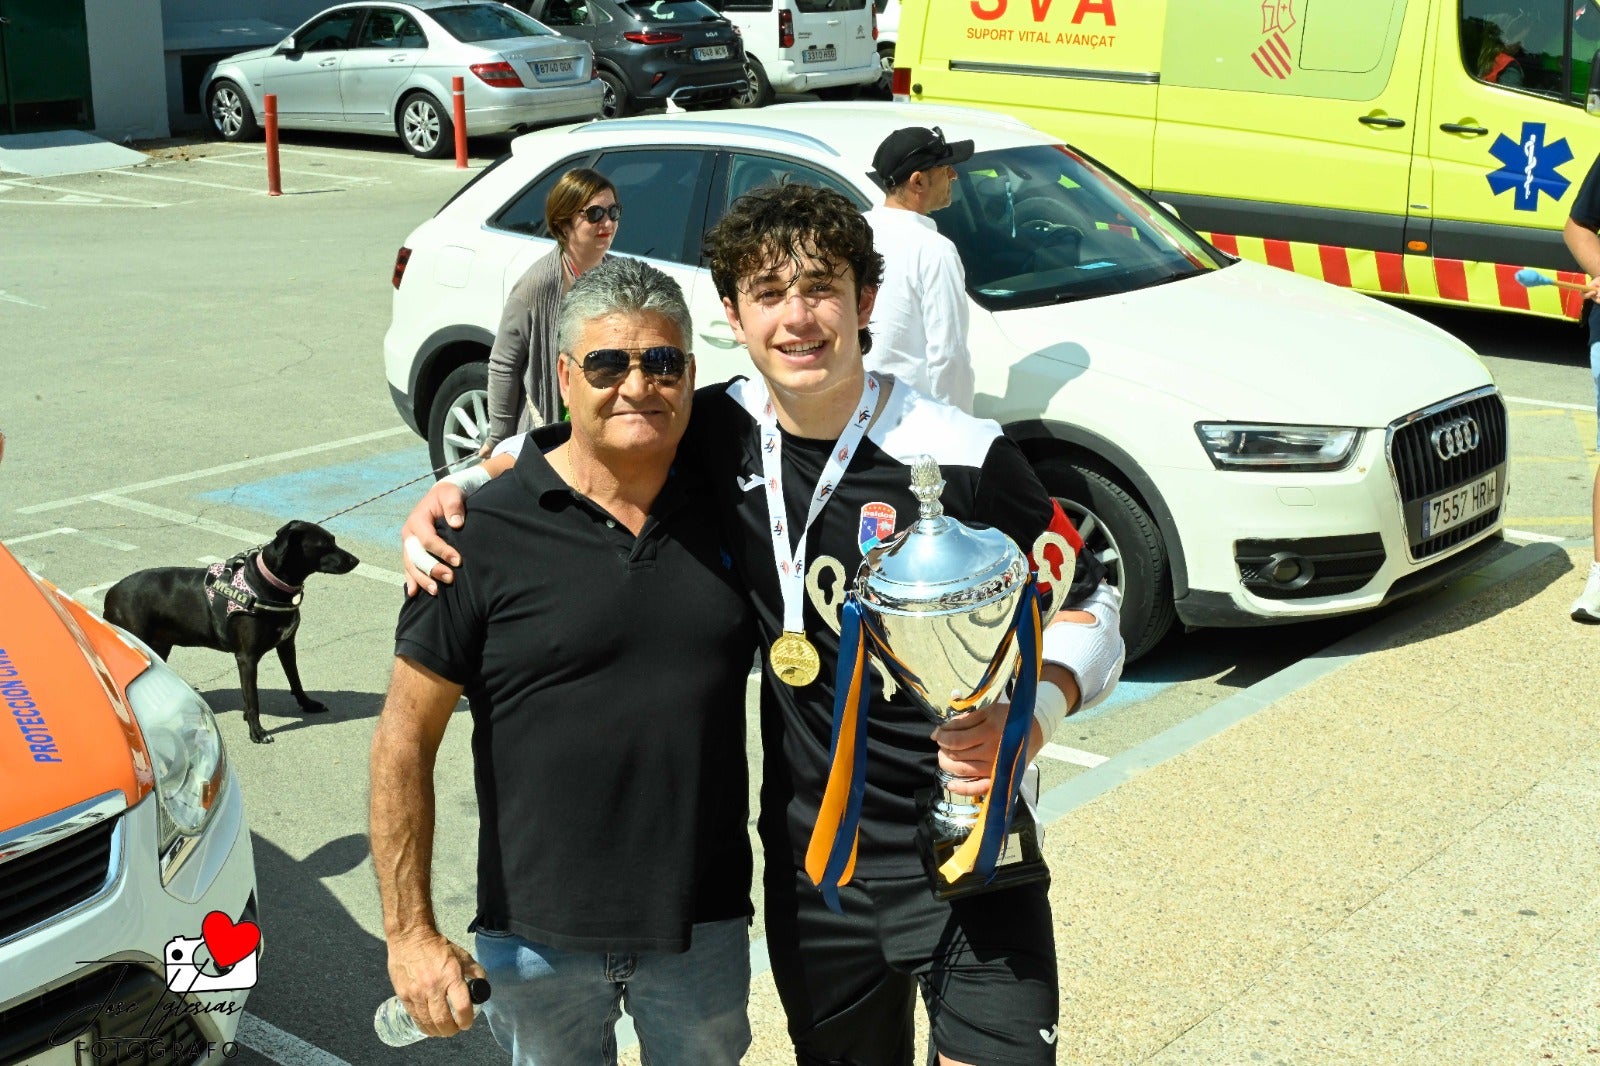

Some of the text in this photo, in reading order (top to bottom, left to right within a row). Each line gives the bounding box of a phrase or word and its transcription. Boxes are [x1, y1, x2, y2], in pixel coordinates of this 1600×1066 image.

[966, 27, 1116, 50] SUPORT VITAL AVANÇAT
[1433, 489, 1468, 529] 7557
[0, 648, 63, 763] PROTECCION CIV
